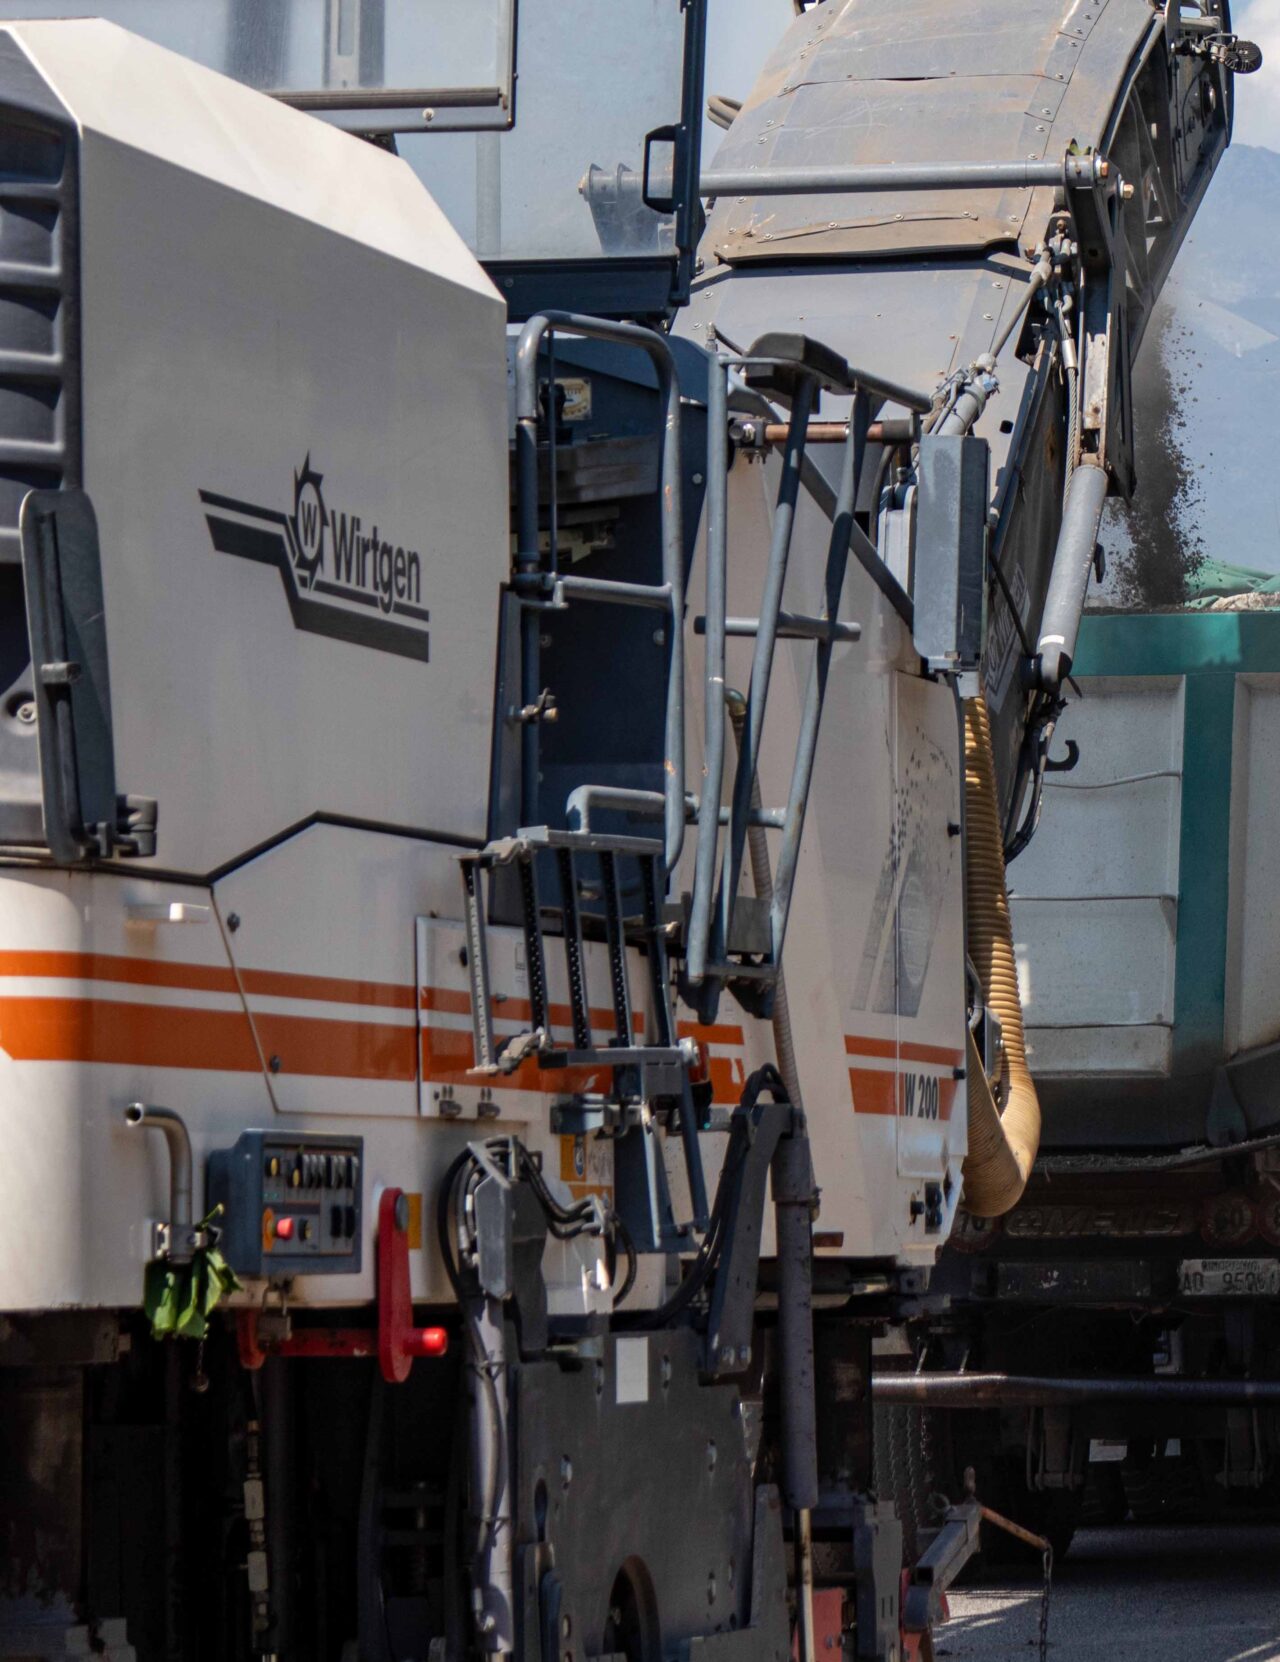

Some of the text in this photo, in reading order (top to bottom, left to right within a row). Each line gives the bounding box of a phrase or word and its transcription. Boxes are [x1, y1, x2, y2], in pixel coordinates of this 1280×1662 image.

[301, 500, 317, 548] W
[331, 509, 420, 614] Wirtgen
[905, 1073, 938, 1120] W 200
